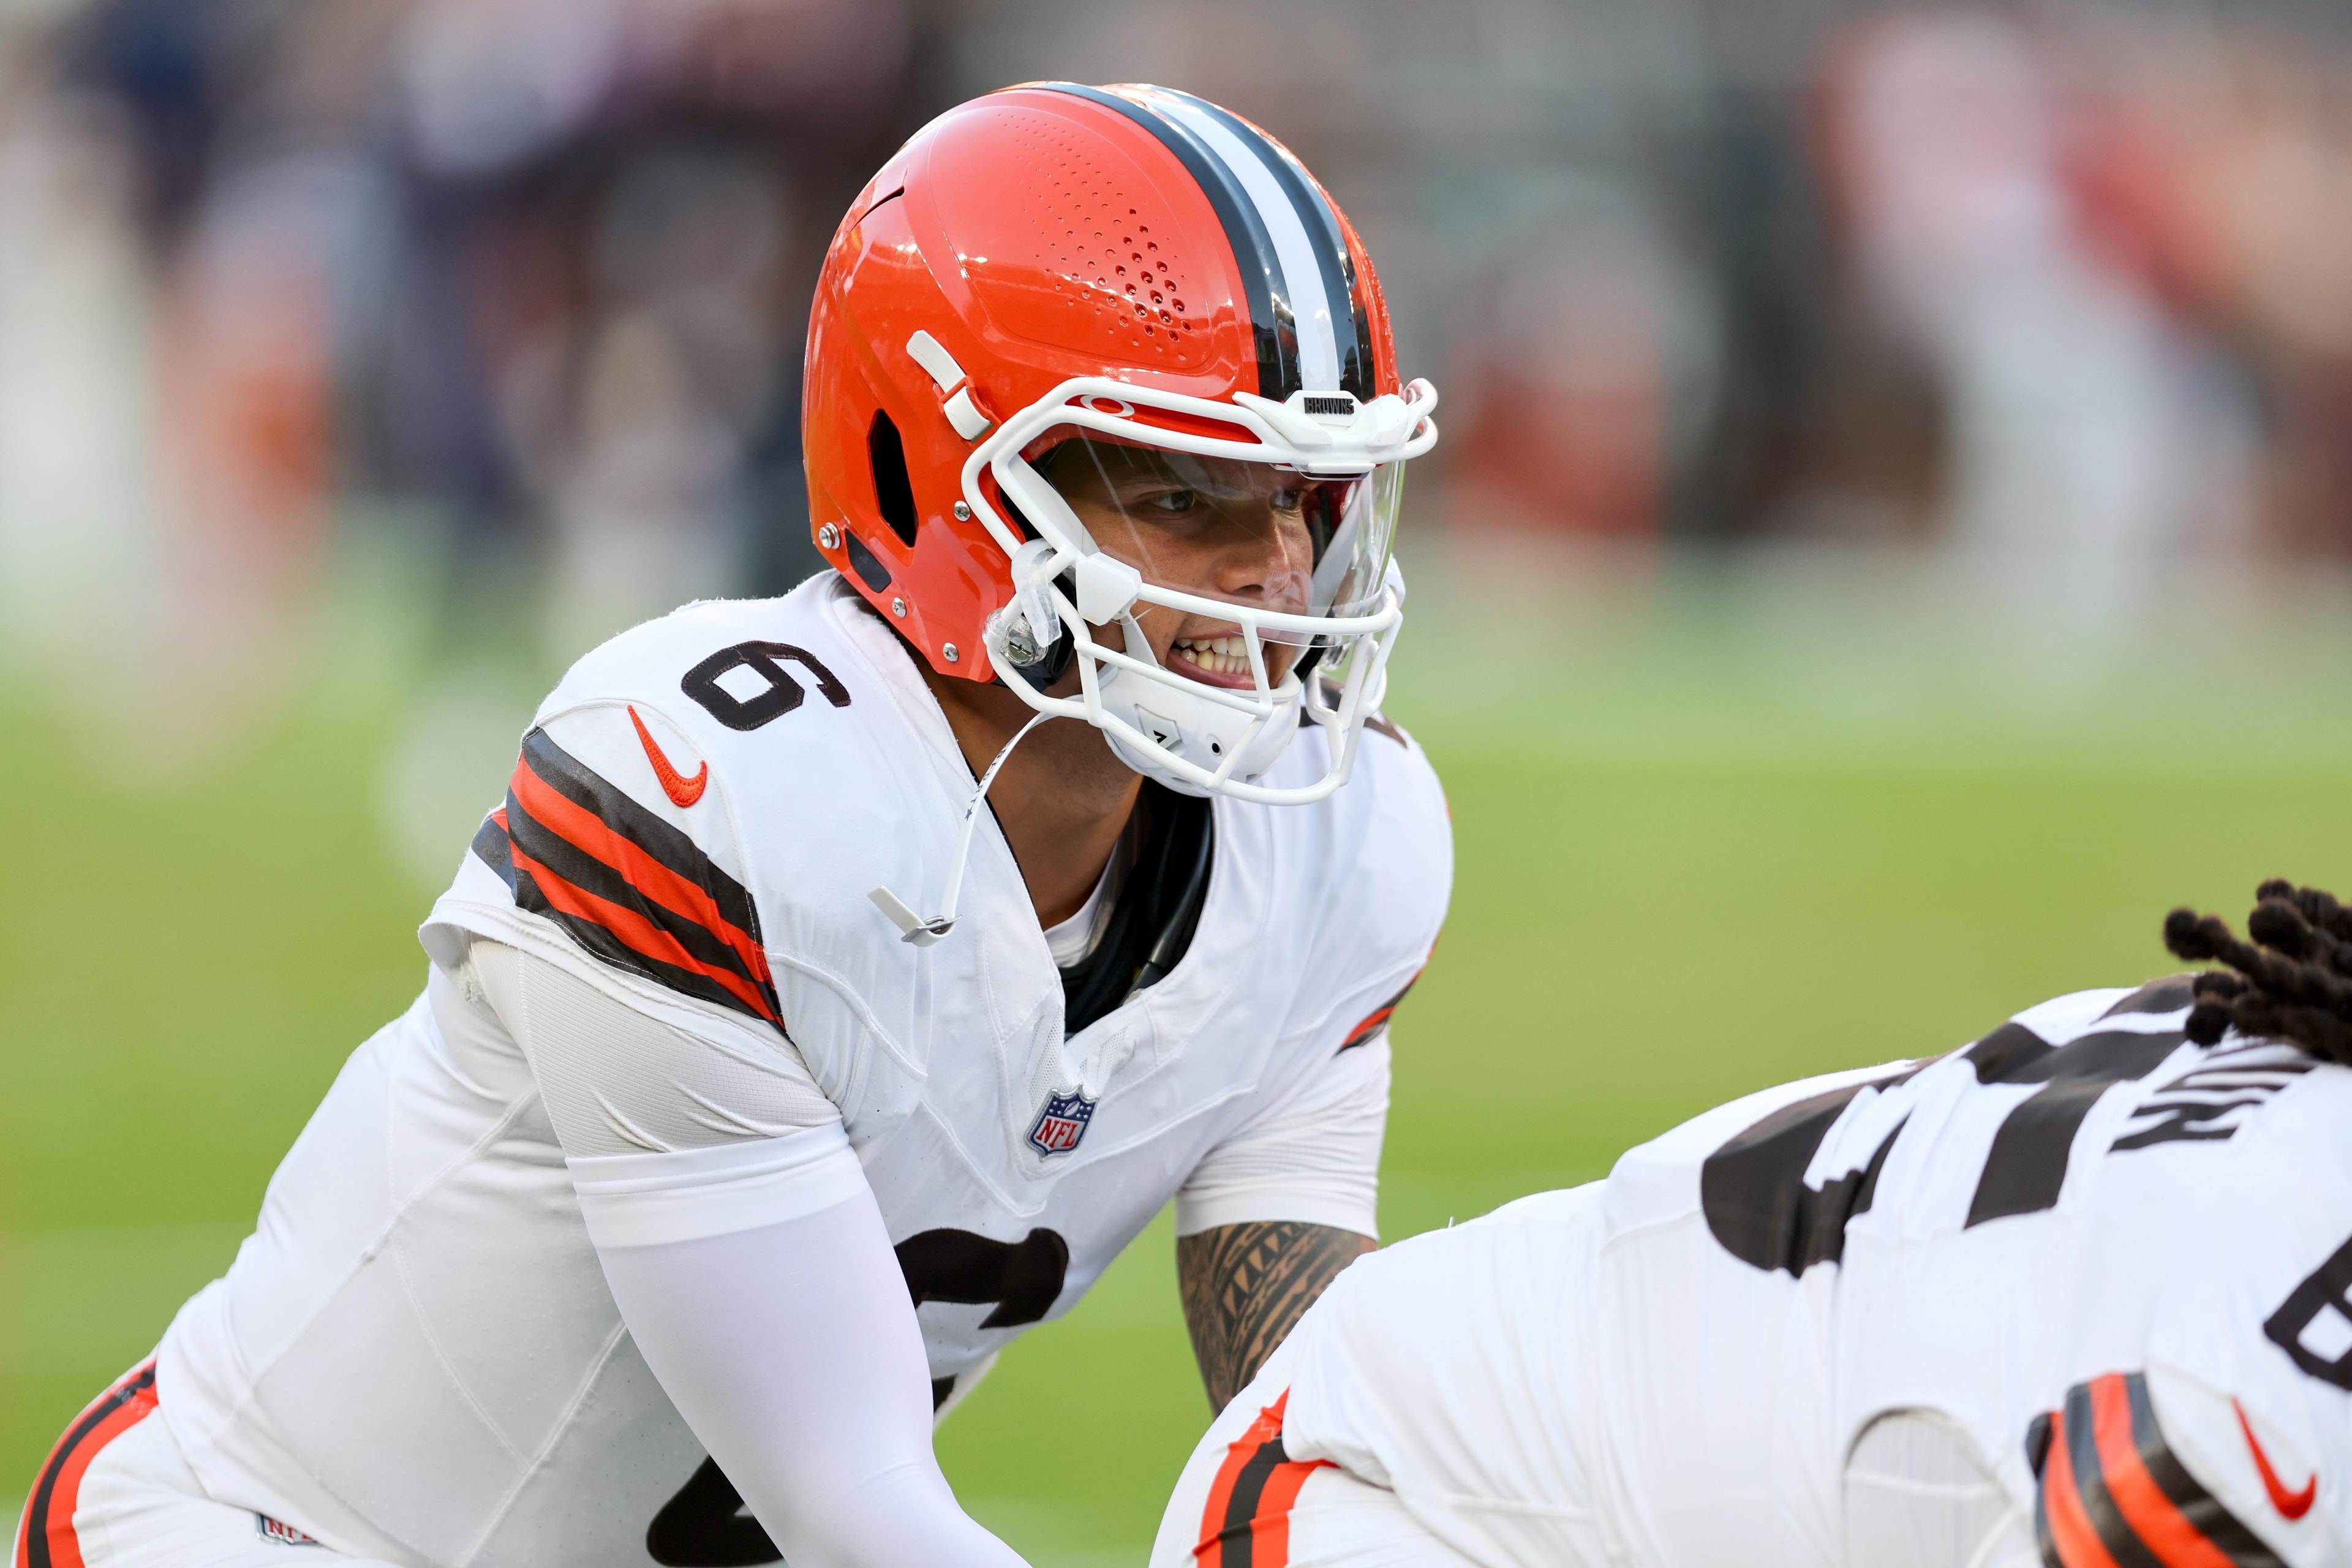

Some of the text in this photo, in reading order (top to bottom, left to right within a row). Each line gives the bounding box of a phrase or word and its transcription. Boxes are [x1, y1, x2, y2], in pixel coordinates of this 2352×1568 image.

[1303, 397, 1354, 415] BROWNS
[680, 640, 851, 731] 6
[1036, 1117, 1079, 1148] NFL
